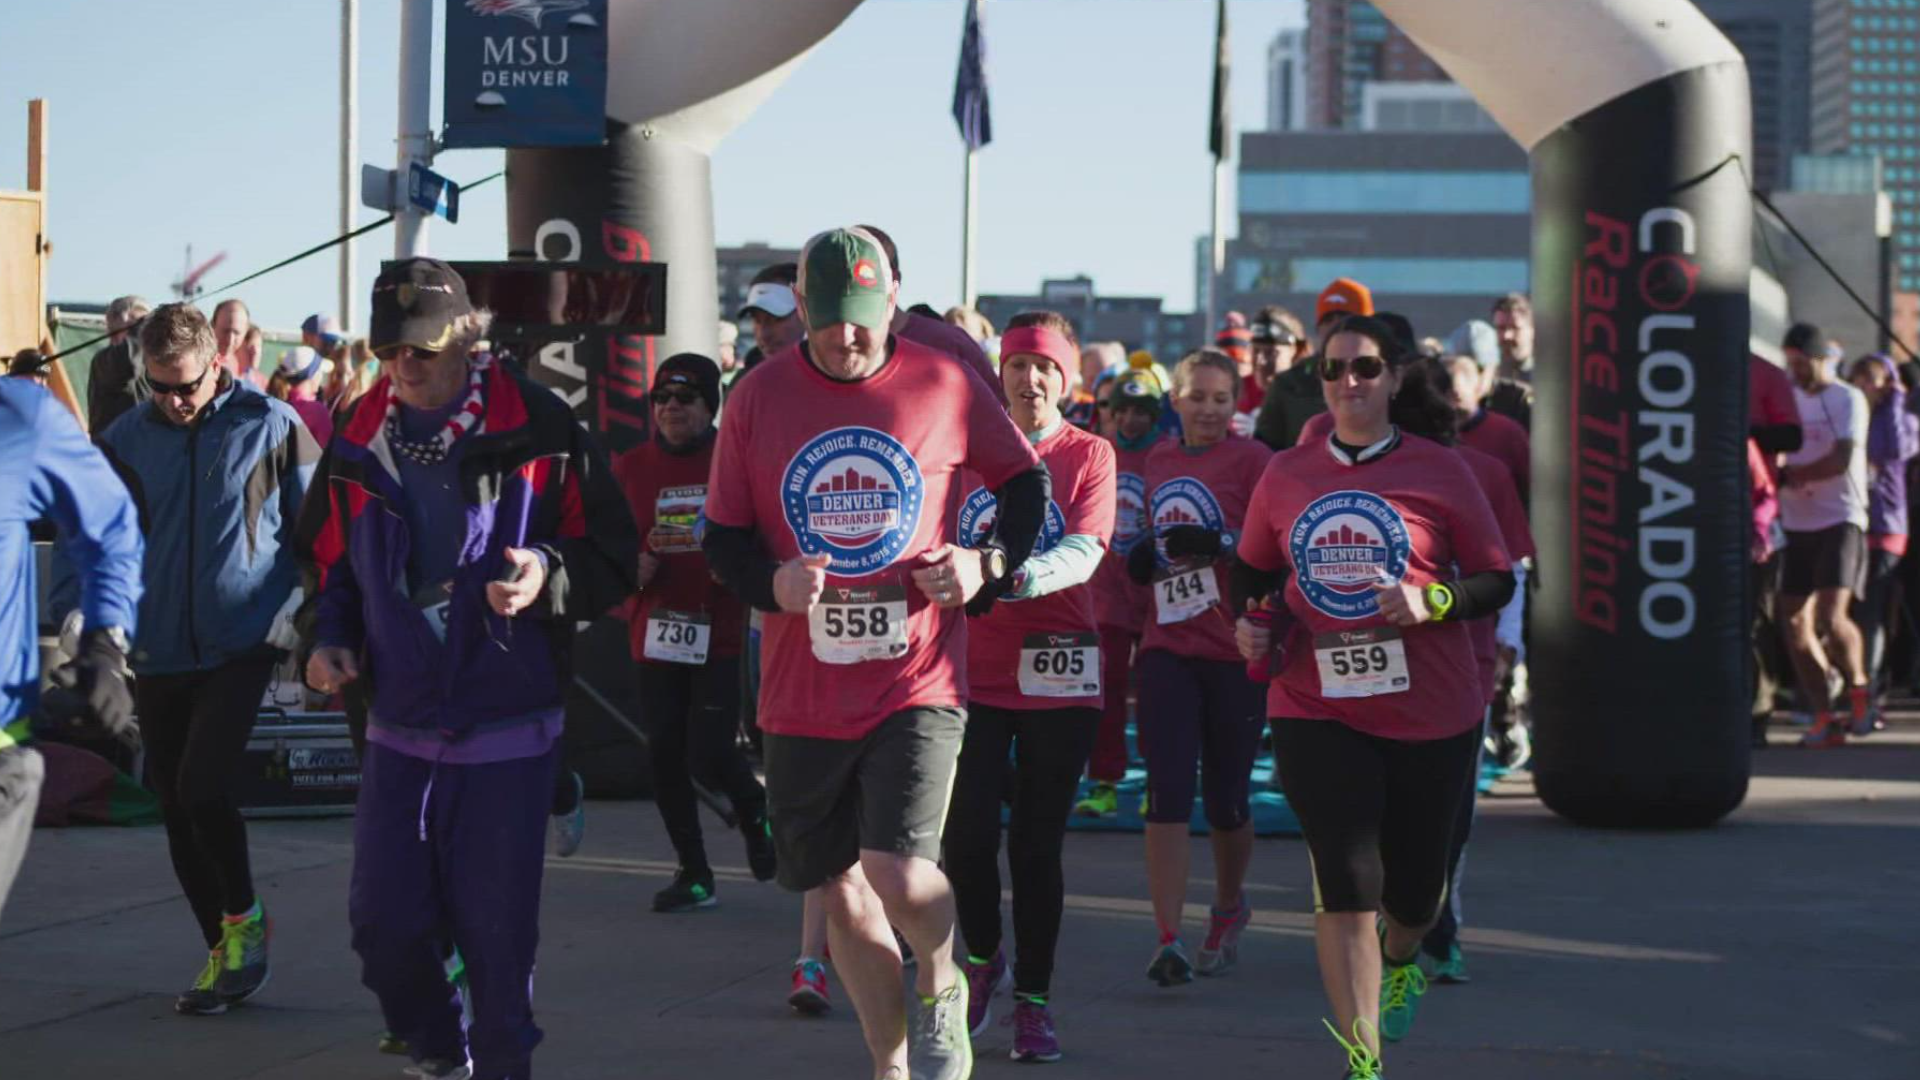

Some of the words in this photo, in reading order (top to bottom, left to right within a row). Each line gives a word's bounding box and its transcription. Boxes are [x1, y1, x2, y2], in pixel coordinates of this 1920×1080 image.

[483, 36, 570, 66] MSU
[482, 70, 570, 87] DENVER
[1584, 209, 1632, 393] Race
[822, 493, 883, 511] DENVER
[812, 511, 871, 527] VETERANS
[873, 508, 895, 523] DAY
[1576, 410, 1631, 635] Timing
[1320, 547, 1373, 562] DENVER
[1313, 563, 1364, 576] VETERANS
[1163, 572, 1205, 604] 744
[657, 621, 697, 646] 730
[825, 606, 889, 638] 558
[1033, 650, 1085, 675] 605
[1331, 646, 1388, 676] 559
